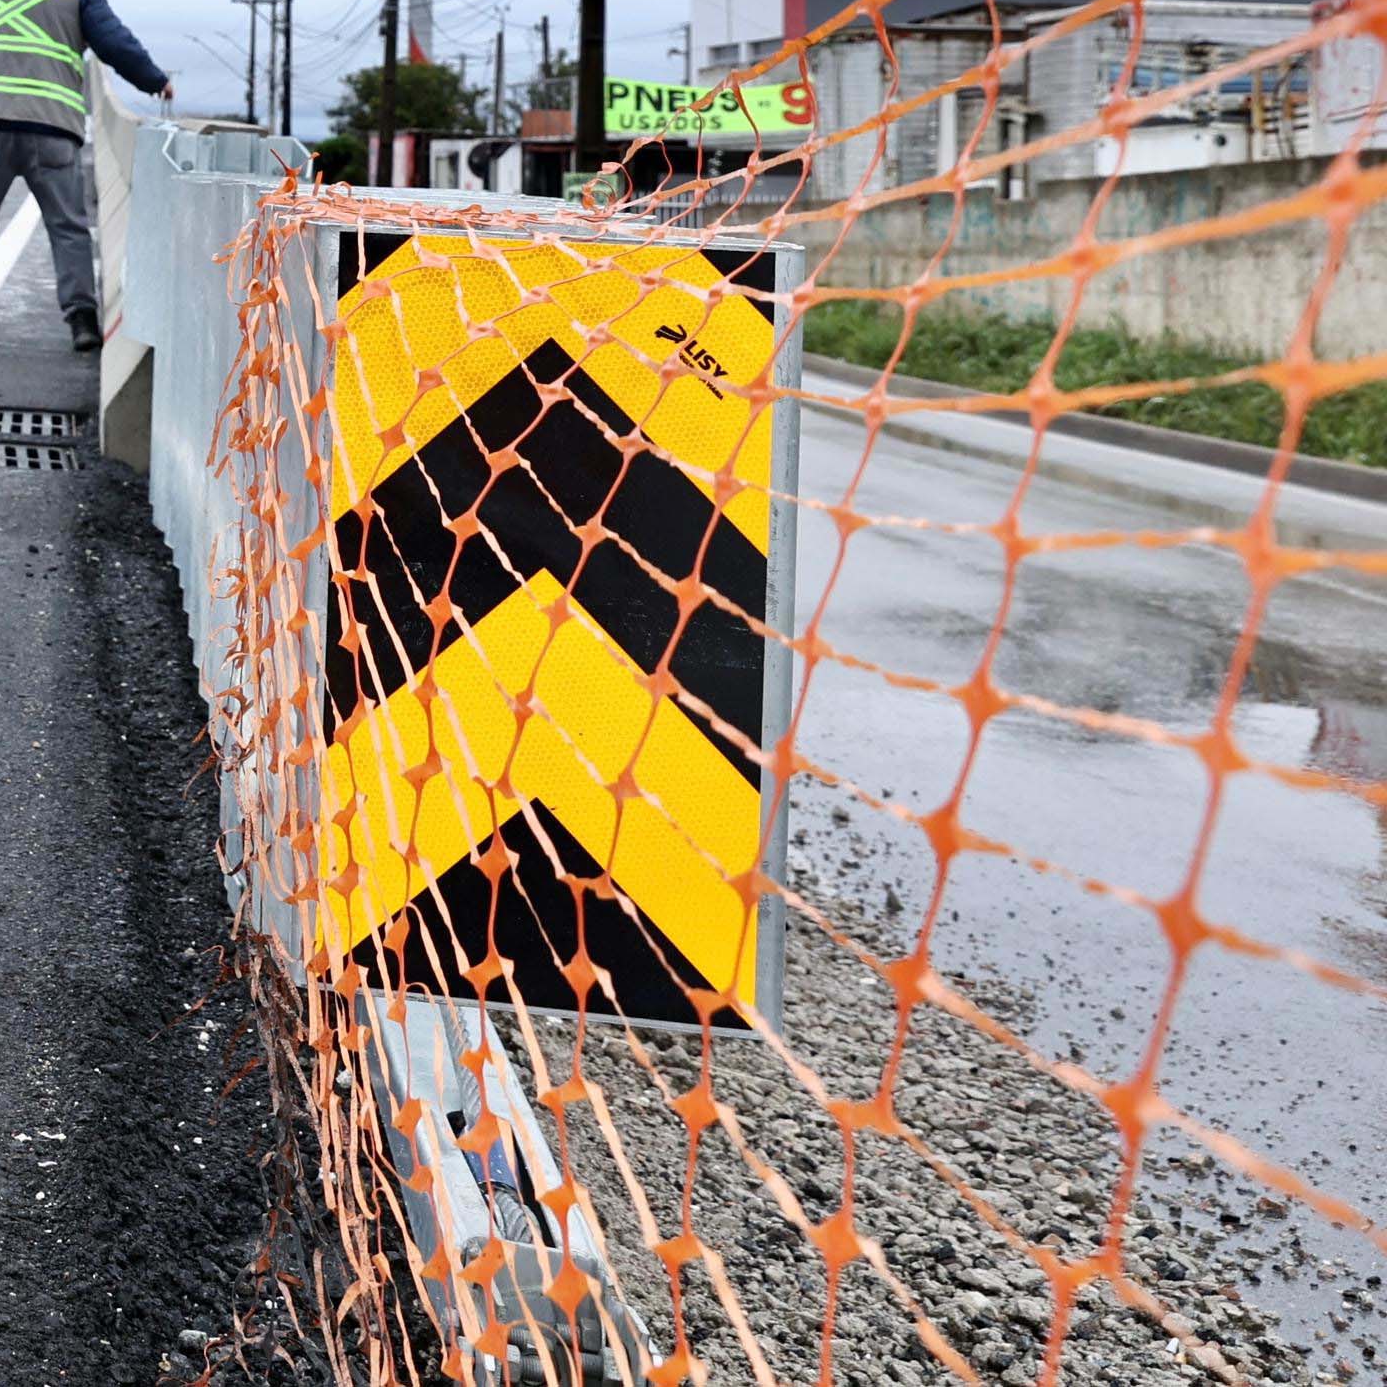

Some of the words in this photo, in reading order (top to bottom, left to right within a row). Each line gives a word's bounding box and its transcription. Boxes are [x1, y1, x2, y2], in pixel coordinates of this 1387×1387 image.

[607, 82, 739, 112] PNEUS
[619, 113, 723, 131] USADOS
[684, 340, 729, 377] LISY
